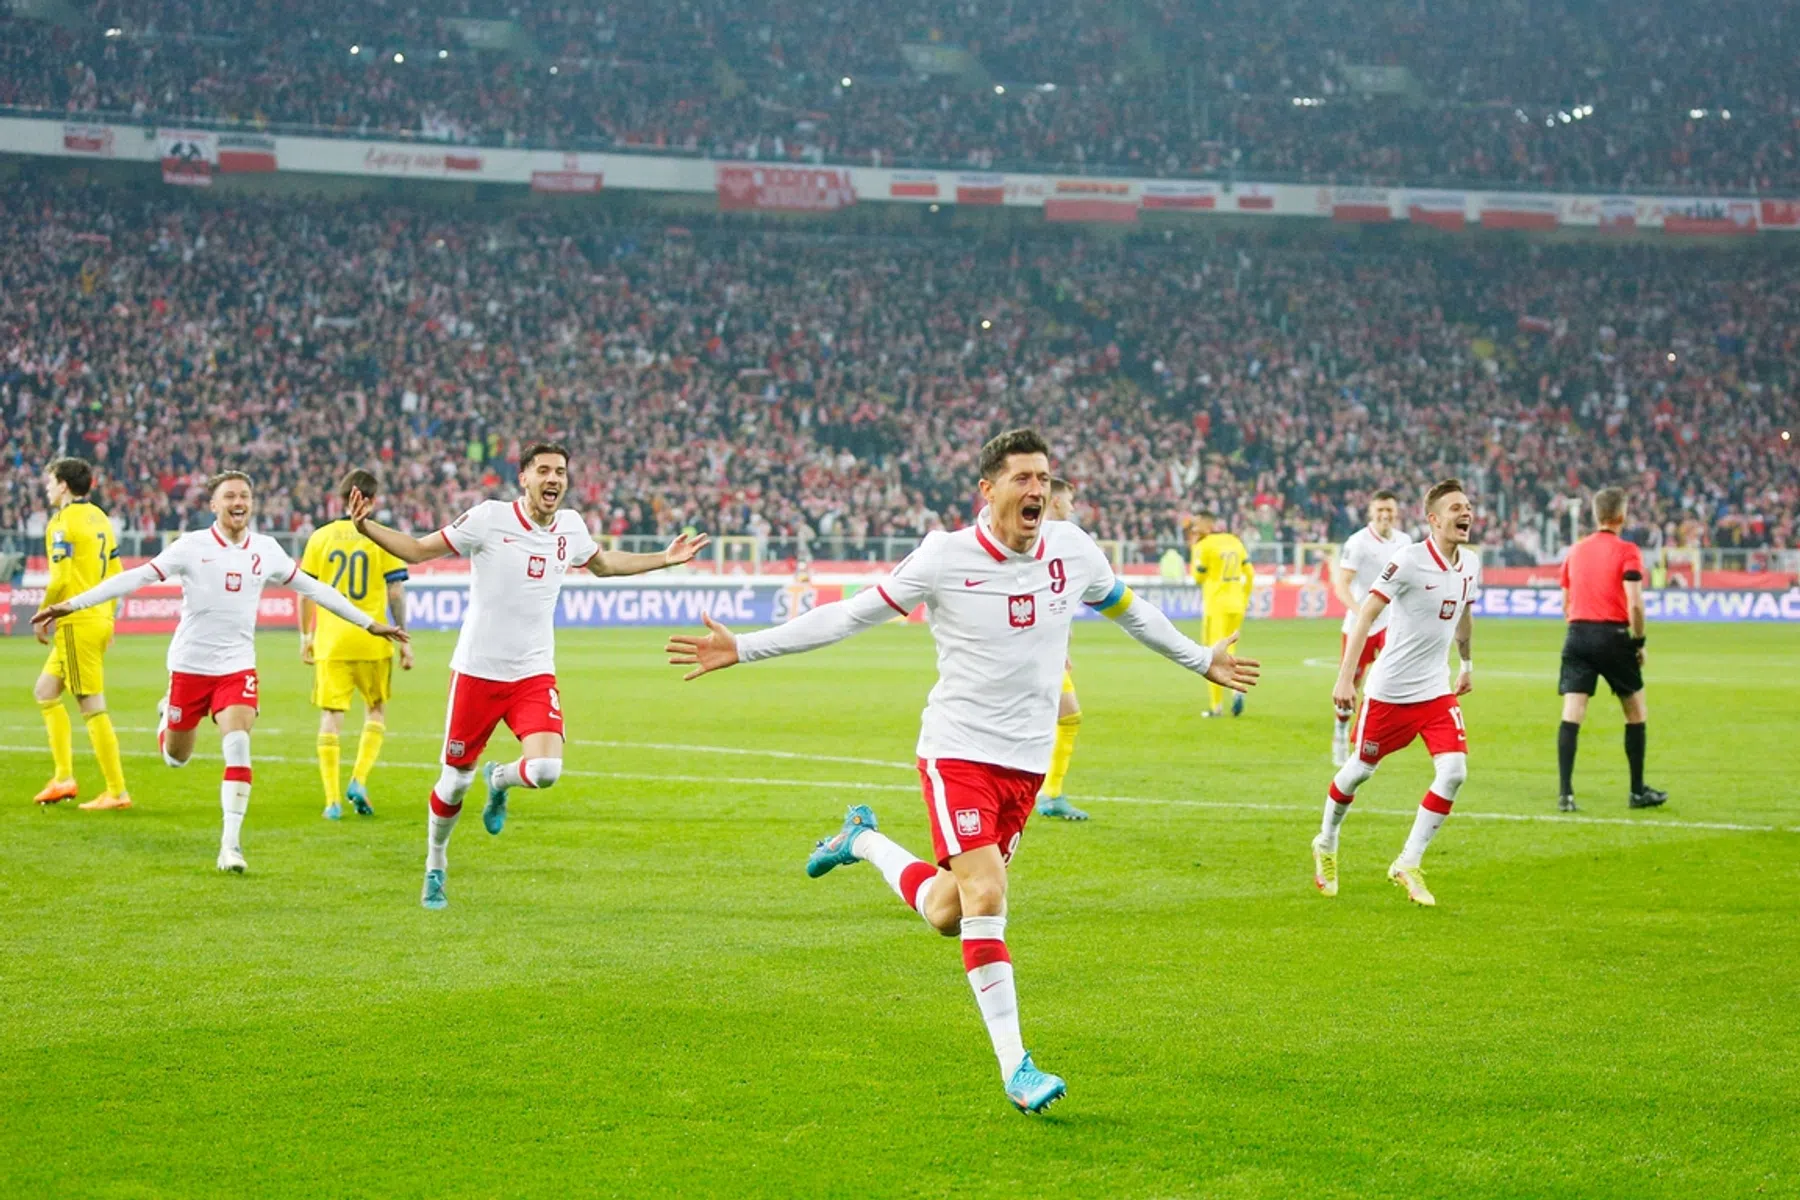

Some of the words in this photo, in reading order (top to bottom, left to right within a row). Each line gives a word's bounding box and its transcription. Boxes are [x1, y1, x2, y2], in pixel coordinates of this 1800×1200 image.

[557, 535, 567, 561] 8
[251, 552, 261, 576] 2
[328, 549, 369, 601] 20
[1048, 558, 1067, 594] 9
[562, 583, 755, 621] WYGRYWAĆ
[548, 687, 560, 711] 8
